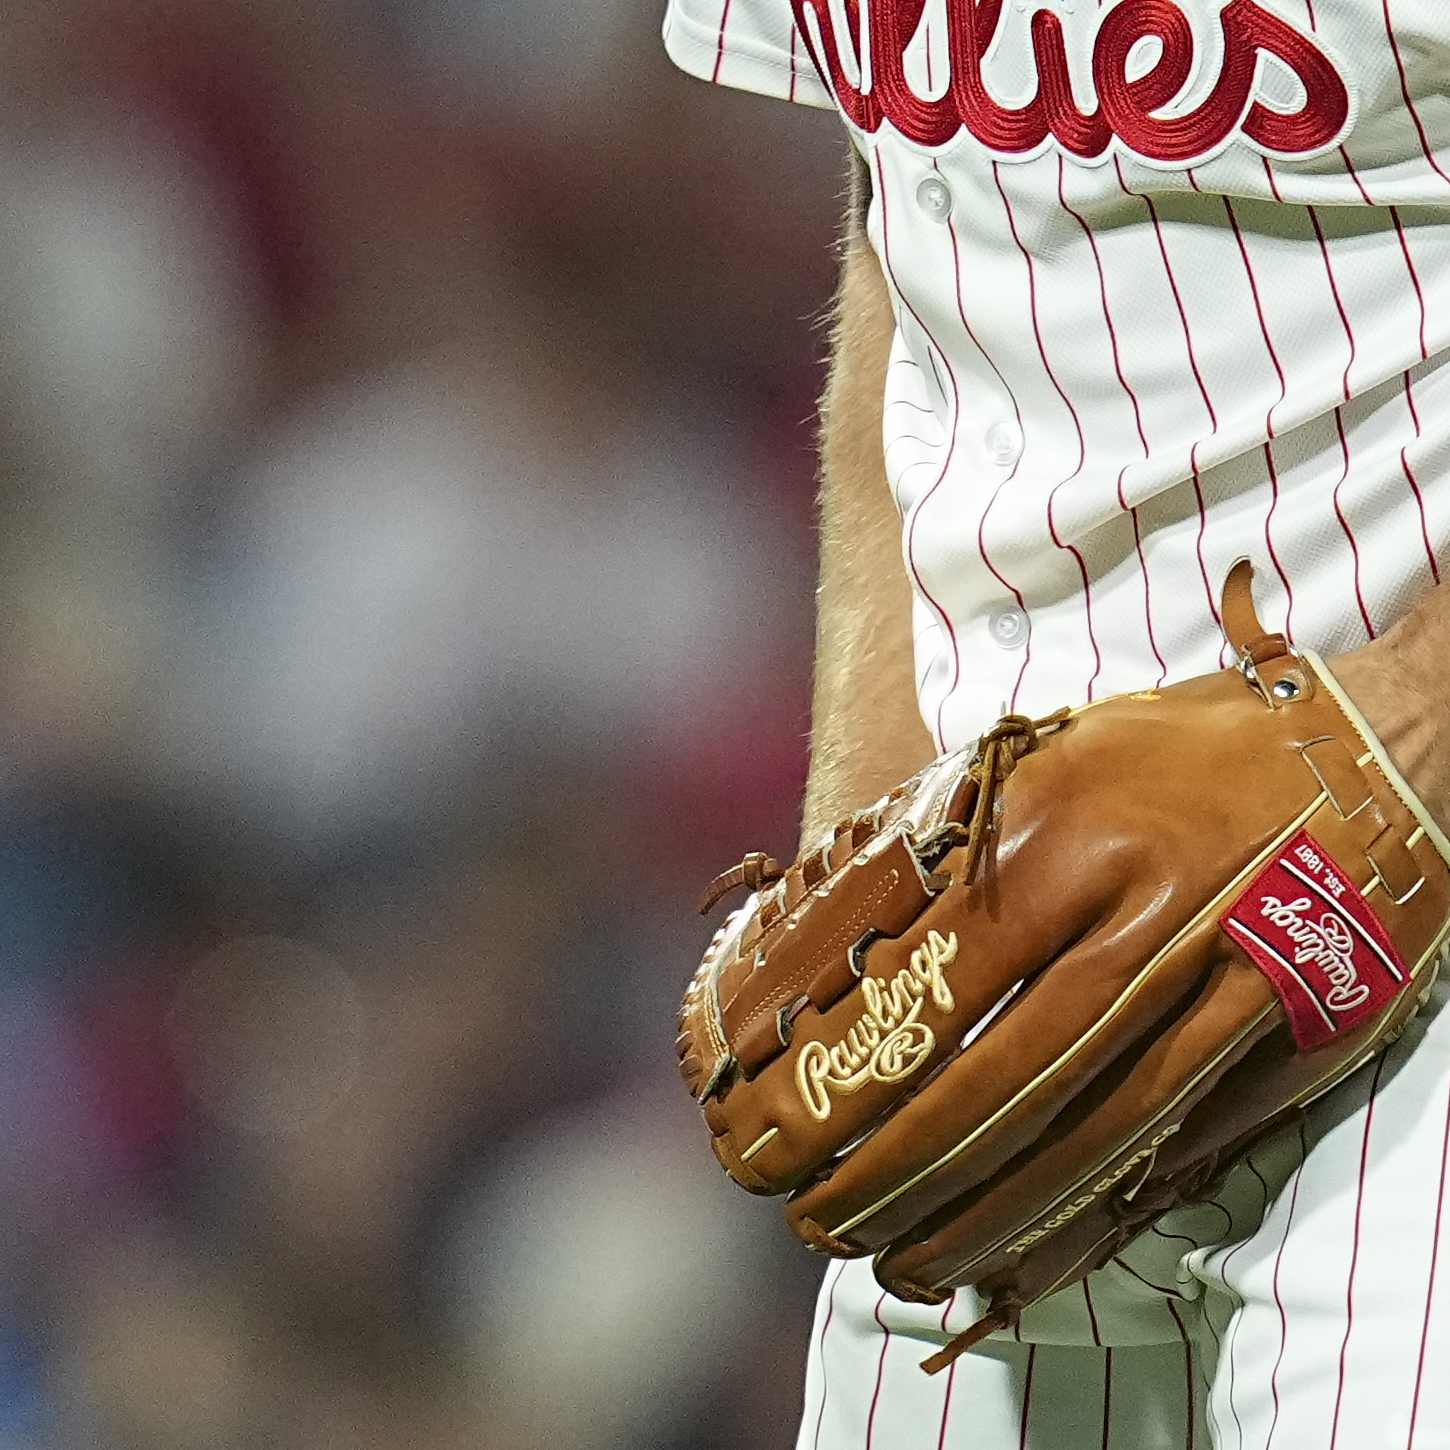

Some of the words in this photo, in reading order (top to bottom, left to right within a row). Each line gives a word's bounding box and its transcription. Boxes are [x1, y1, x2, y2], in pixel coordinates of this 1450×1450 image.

[1293, 843, 1325, 875] 1887
[1260, 896, 1371, 1012] Rawlings
[795, 929, 959, 1122] Rawlings
